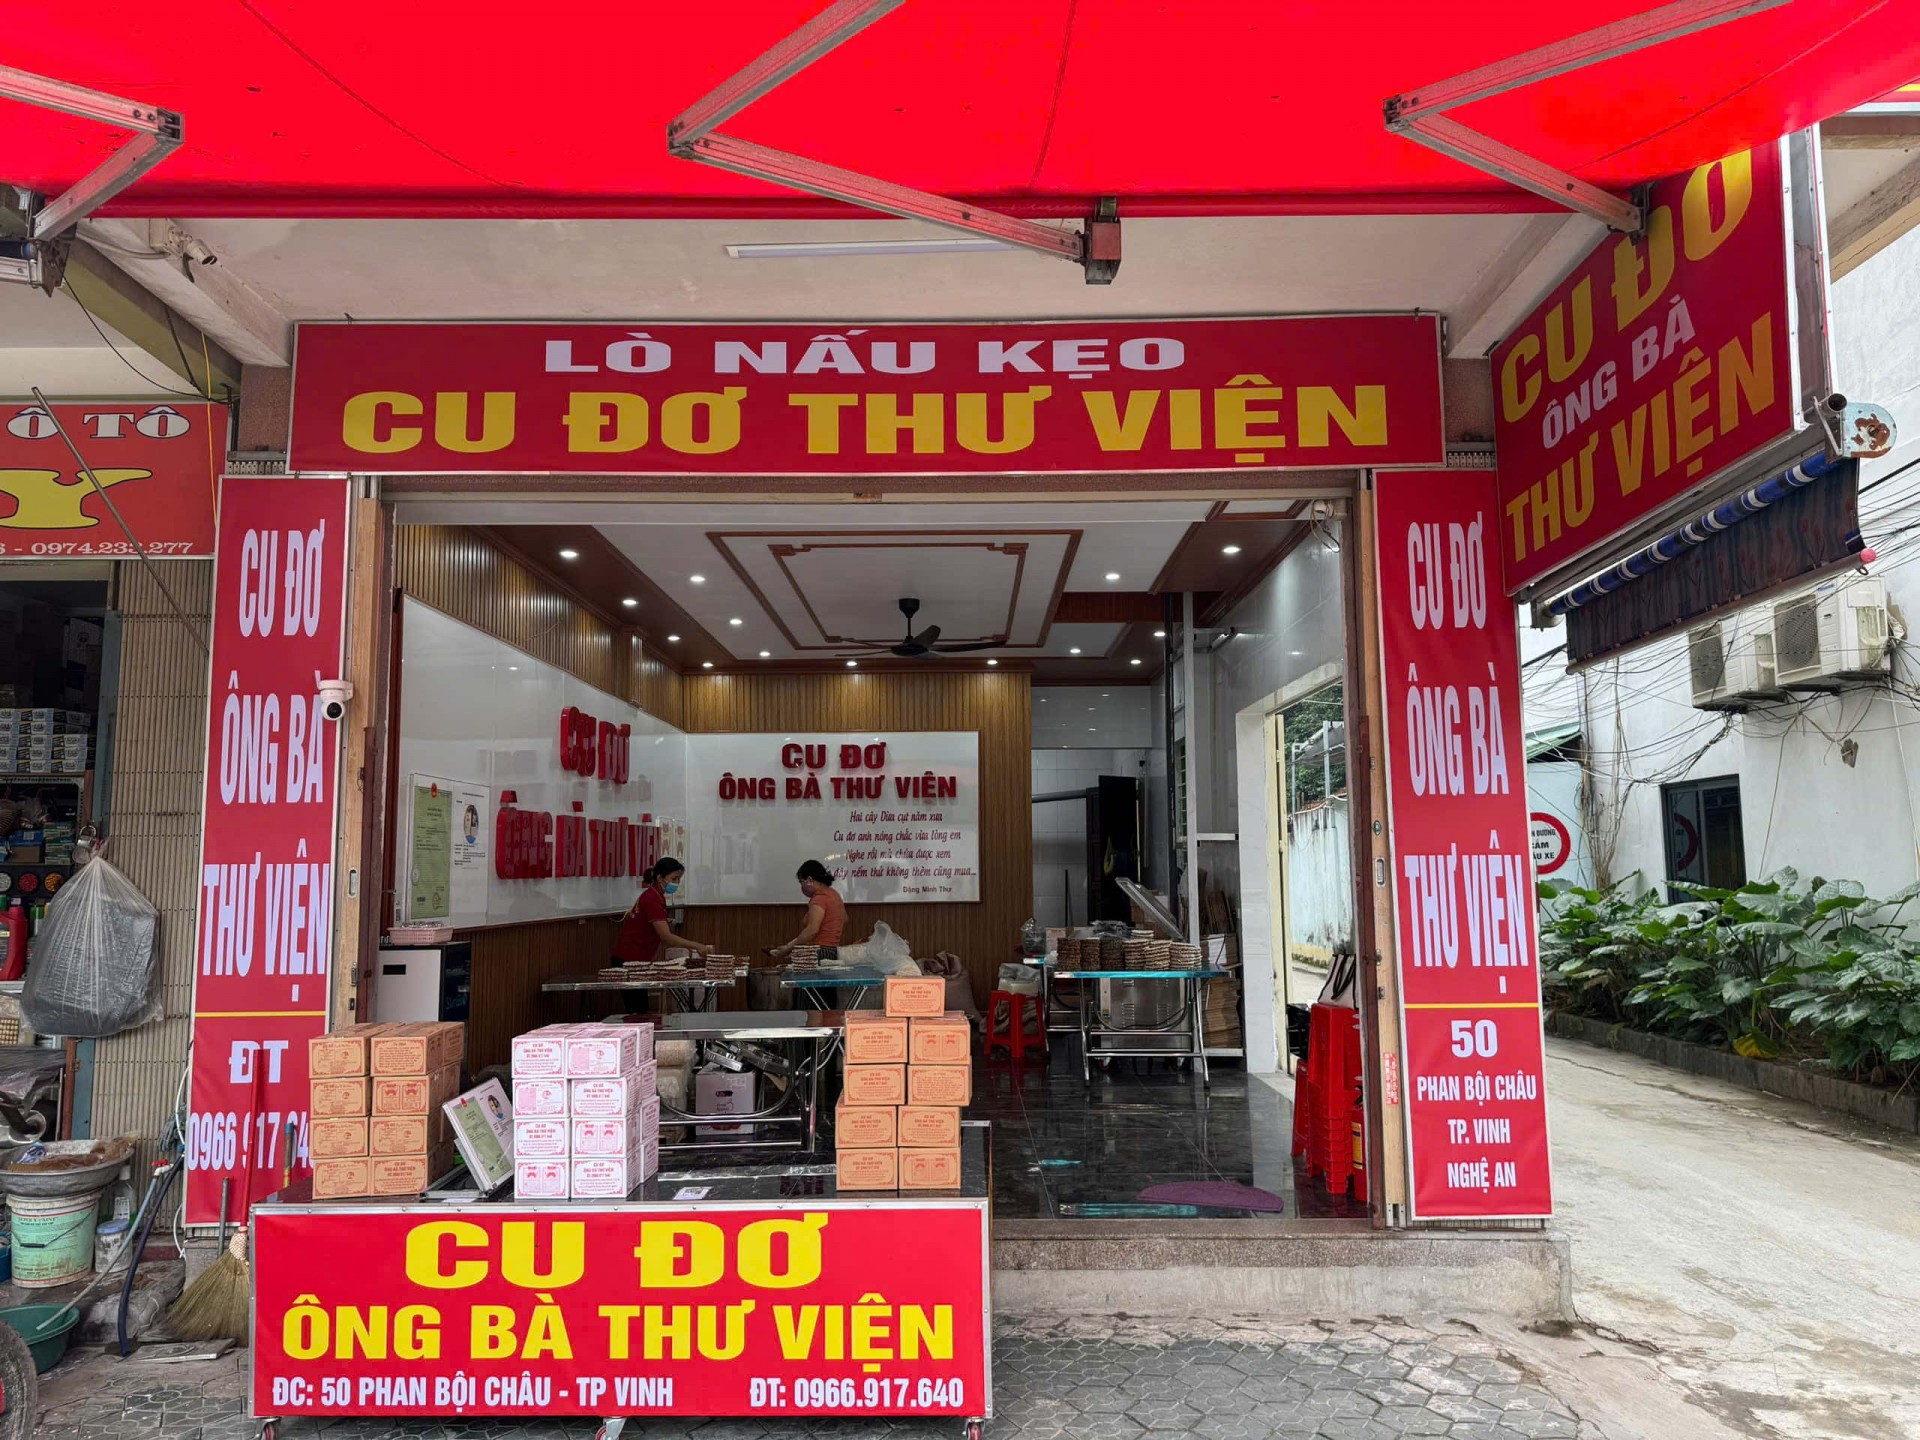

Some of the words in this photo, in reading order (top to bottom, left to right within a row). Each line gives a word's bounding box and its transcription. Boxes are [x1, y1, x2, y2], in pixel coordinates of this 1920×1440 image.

[546, 333, 670, 372] LÒ
[715, 330, 935, 373] NẤU
[979, 338, 1184, 378] KẸO
[1501, 275, 1593, 423] CU
[1542, 360, 1617, 449] ÔNG
[1631, 294, 1696, 382] BÀ
[5, 402, 62, 442] Ô
[80, 402, 192, 440] TÔ
[343, 392, 515, 453] CU
[563, 387, 746, 453] ĐƠ
[789, 386, 1051, 453] THƯ
[1082, 374, 1388, 463] VIỆN
[1506, 433, 1598, 563] THƯ
[1611, 311, 1775, 496] VIỆN
[240, 530, 277, 637] CU
[284, 519, 325, 636] ĐƠ
[1409, 523, 1443, 629] CU
[1450, 511, 1487, 629] ĐƠ
[221, 671, 279, 804] ÔNG
[287, 671, 324, 802] BÀ
[1408, 663, 1464, 796] ÔNG
[1469, 663, 1509, 794] BÀ
[781, 743, 827, 769] CU
[839, 742, 887, 769] ĐƠ
[718, 772, 776, 799] ÔNG
[785, 773, 822, 799] BÀ
[830, 775, 885, 798] THƯ
[555, 801, 587, 878] BÀ
[588, 817, 629, 878] THƯ
[833, 830, 843, 842] Cu
[857, 832, 872, 841] anh
[850, 810, 863, 822] Hai
[865, 811, 878, 824] cây
[846, 849, 865, 862] Nghe
[935, 851, 951, 859] xem
[886, 866, 910, 879] không
[1544, 852, 1555, 860] XE
[203, 852, 262, 977] THƯ
[265, 839, 329, 1002] VIỆN
[1404, 843, 1458, 968] THƯ
[1462, 830, 1528, 993] VIỆN
[1452, 1020, 1497, 1057] 50
[229, 1041, 288, 1083] ĐT
[1417, 1076, 1460, 1101] PHAN
[1464, 1071, 1490, 1106] BỘI
[1495, 1070, 1536, 1100] CHÂU
[187, 1112, 236, 1170] 0966
[1448, 1119, 1469, 1144] TP.
[1473, 1119, 1510, 1143] VINH
[1448, 1157, 1489, 1193] NGHỆ
[1495, 1162, 1516, 1187] AN
[405, 1221, 585, 1288] CU
[634, 1212, 828, 1288] ĐƠ
[283, 1294, 440, 1359] ÔNG
[471, 1293, 573, 1359] BÀ
[599, 1300, 755, 1360] THƯ
[777, 1293, 954, 1372] VIỆN
[273, 1377, 313, 1406] ĐC:
[322, 1378, 350, 1406] 50
[359, 1377, 426, 1405] PHAN
[435, 1371, 475, 1412] BỘI
[485, 1371, 550, 1406] CHÂU
[576, 1378, 606, 1406] TP
[615, 1378, 672, 1406] VINH
[750, 1378, 785, 1407] ĐT:
[795, 1378, 963, 1407] 0966.917.640
